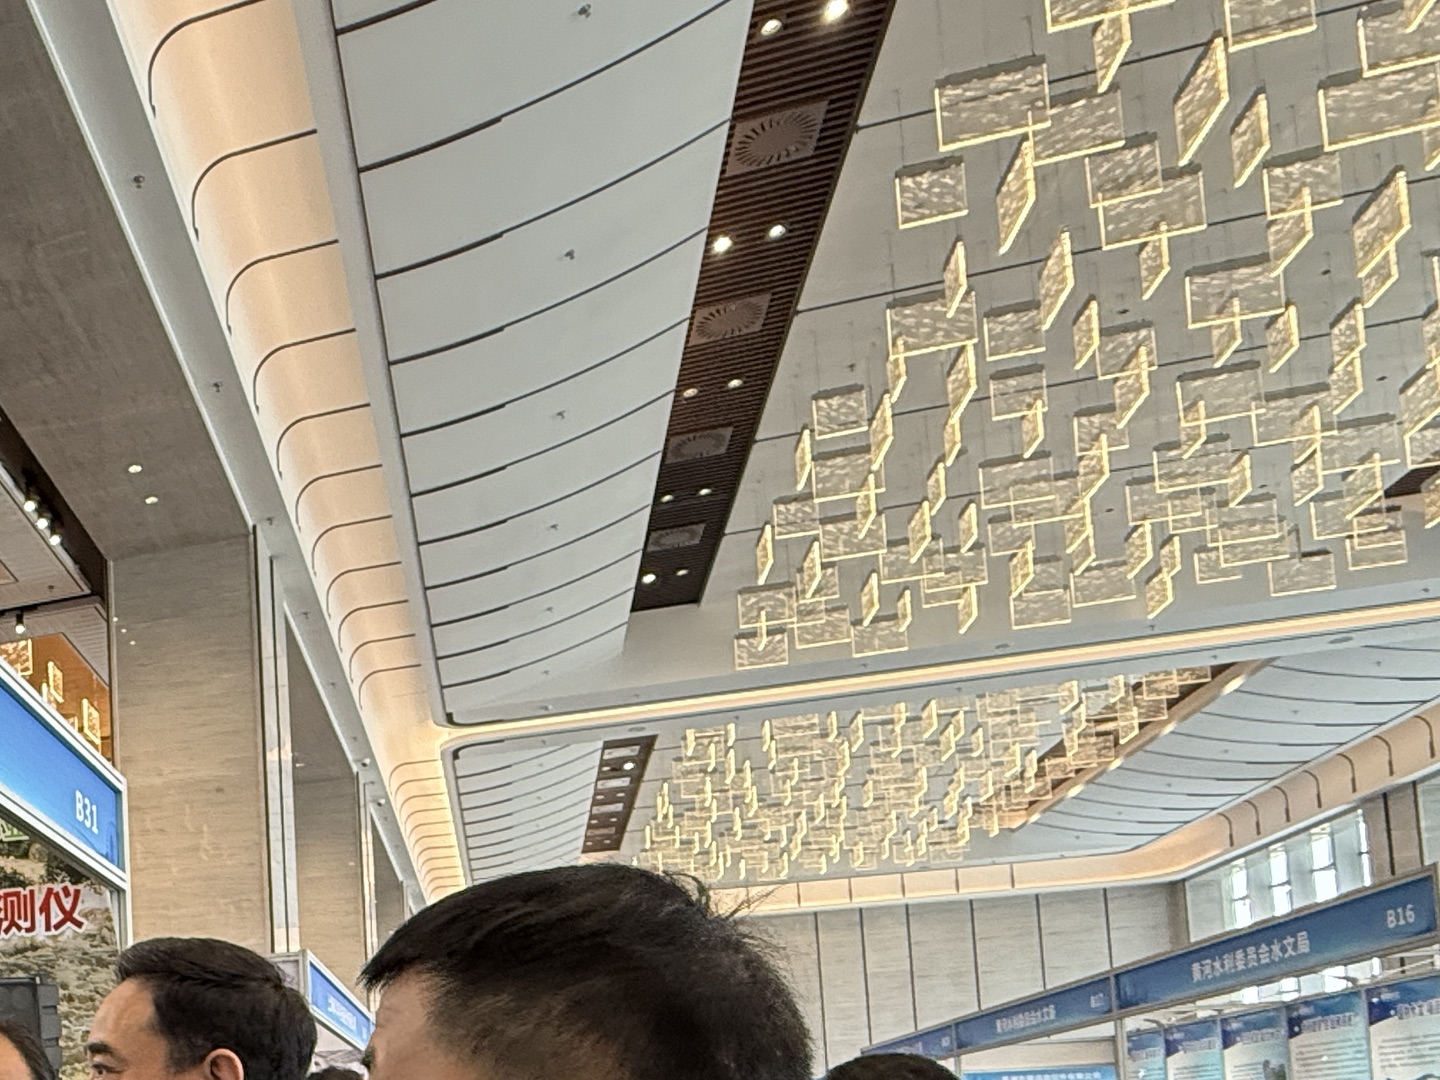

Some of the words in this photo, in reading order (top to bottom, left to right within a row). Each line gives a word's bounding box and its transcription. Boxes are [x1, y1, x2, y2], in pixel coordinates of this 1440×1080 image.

[74, 789, 100, 836] B31
[1386, 903, 1416, 929] B16
[1190, 931, 1311, 984] 黄河水利委员会水文局
